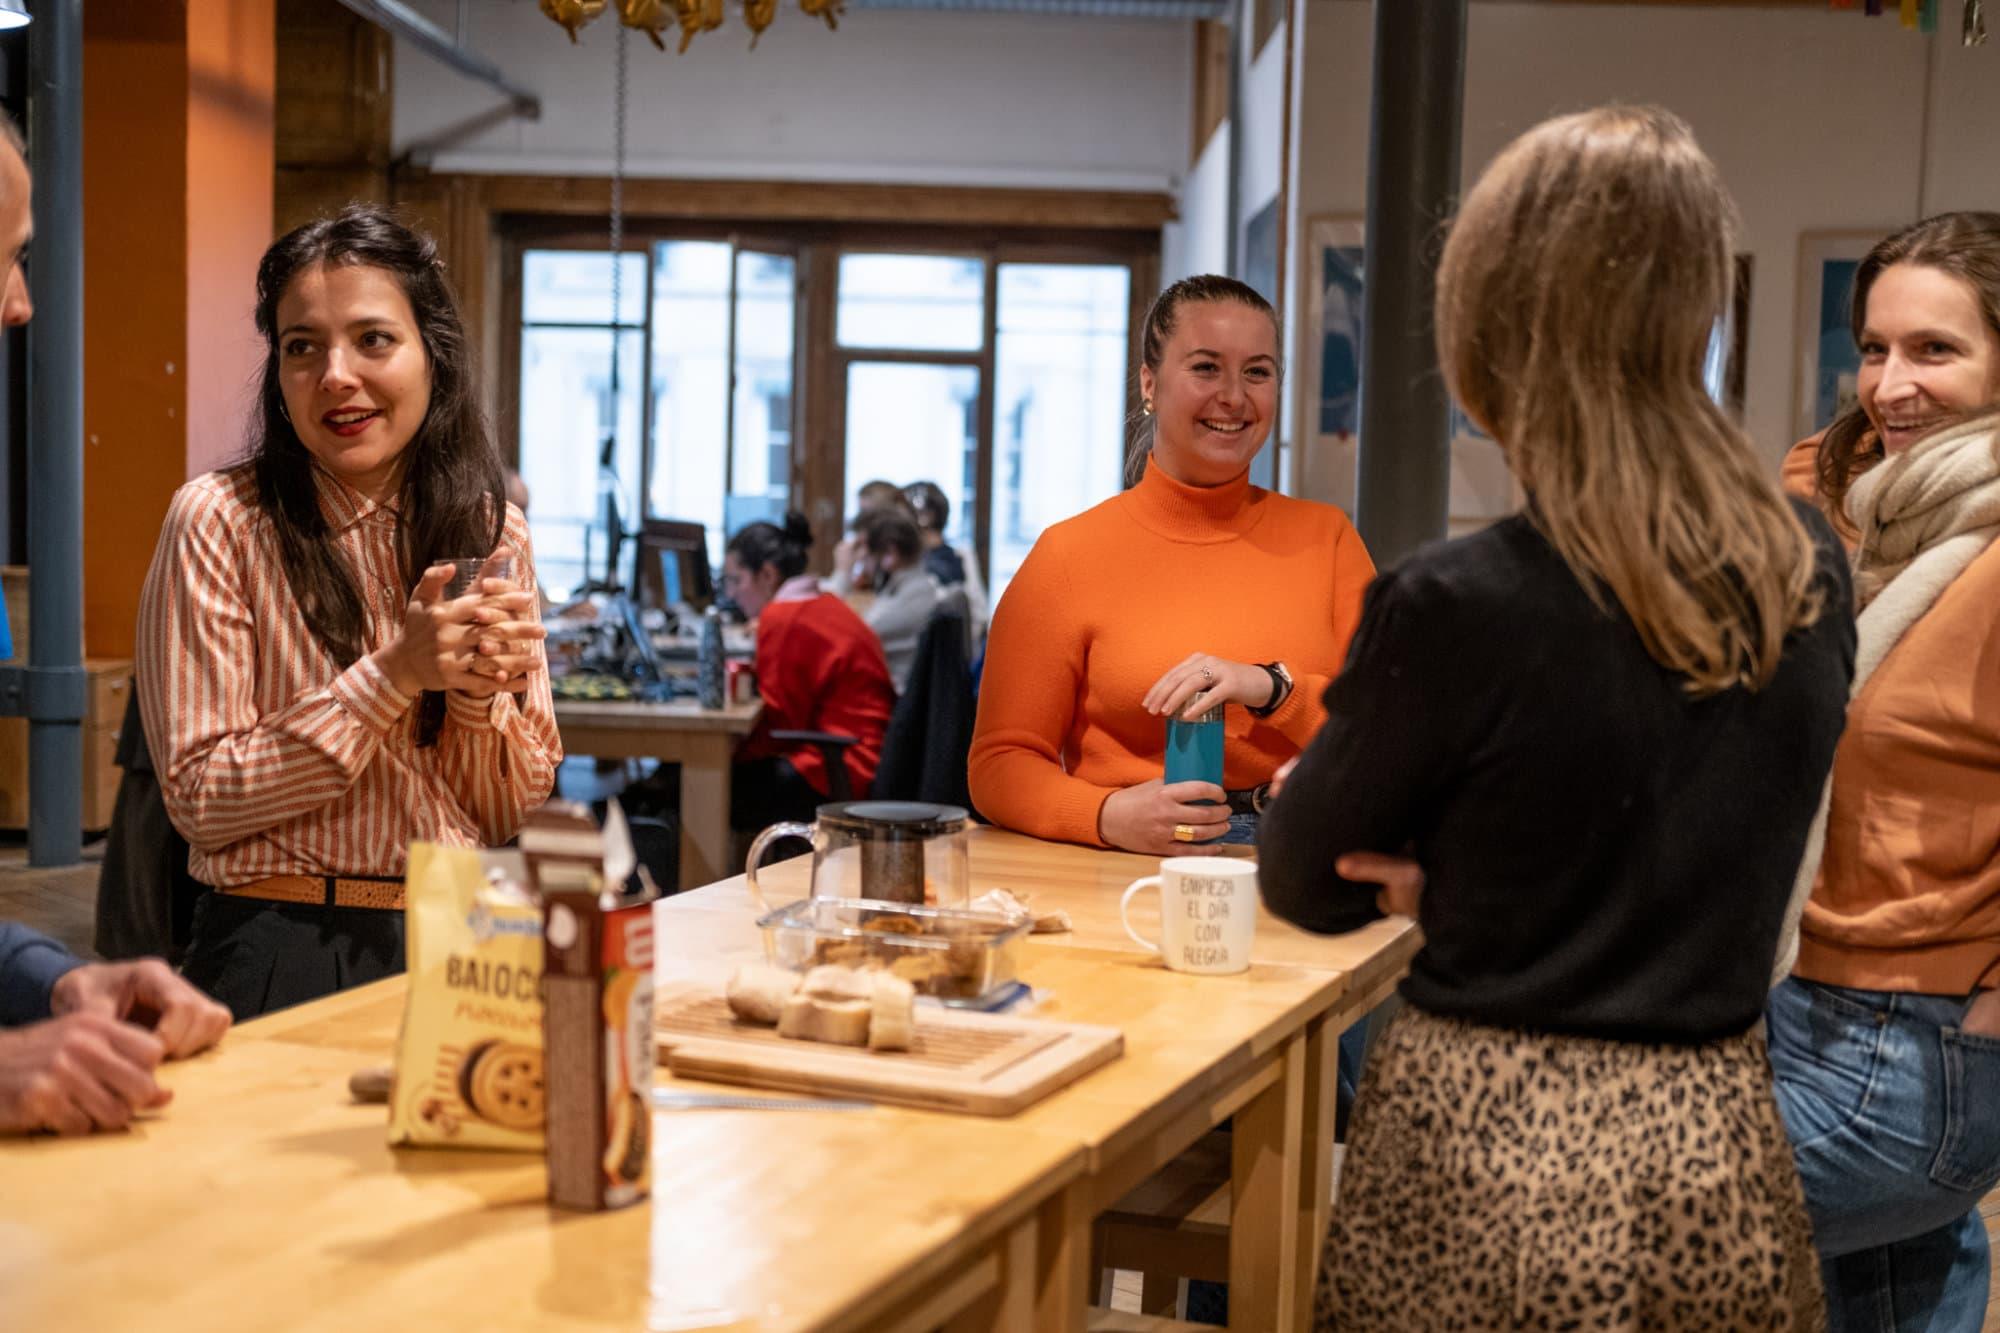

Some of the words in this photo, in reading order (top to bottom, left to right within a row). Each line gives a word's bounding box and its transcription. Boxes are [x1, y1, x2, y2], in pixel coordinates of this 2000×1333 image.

[1180, 877, 1235, 896] EMPIEZA
[1187, 901, 1202, 920] EL
[1194, 924, 1221, 943] CON
